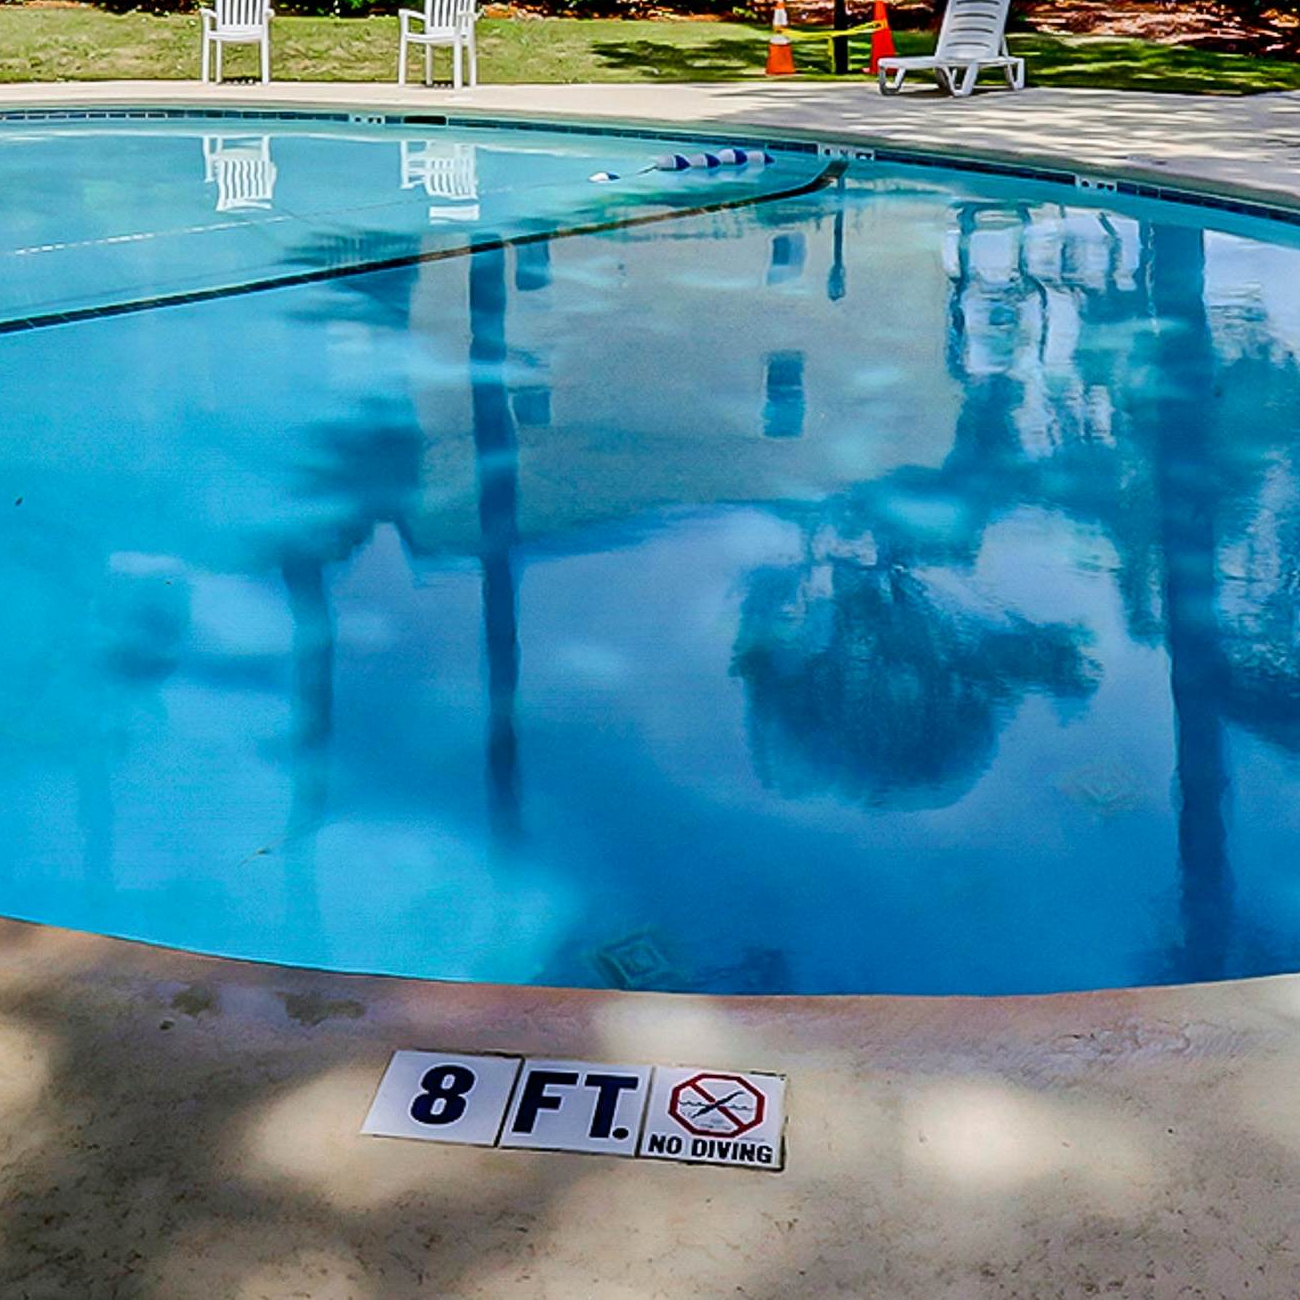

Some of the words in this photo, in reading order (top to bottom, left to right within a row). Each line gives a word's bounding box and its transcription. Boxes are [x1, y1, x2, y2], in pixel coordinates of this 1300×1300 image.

[410, 1065, 476, 1125] 8
[511, 1071, 639, 1140] FT.
[648, 1134, 682, 1154] NO
[691, 1138, 773, 1164] DIVING
